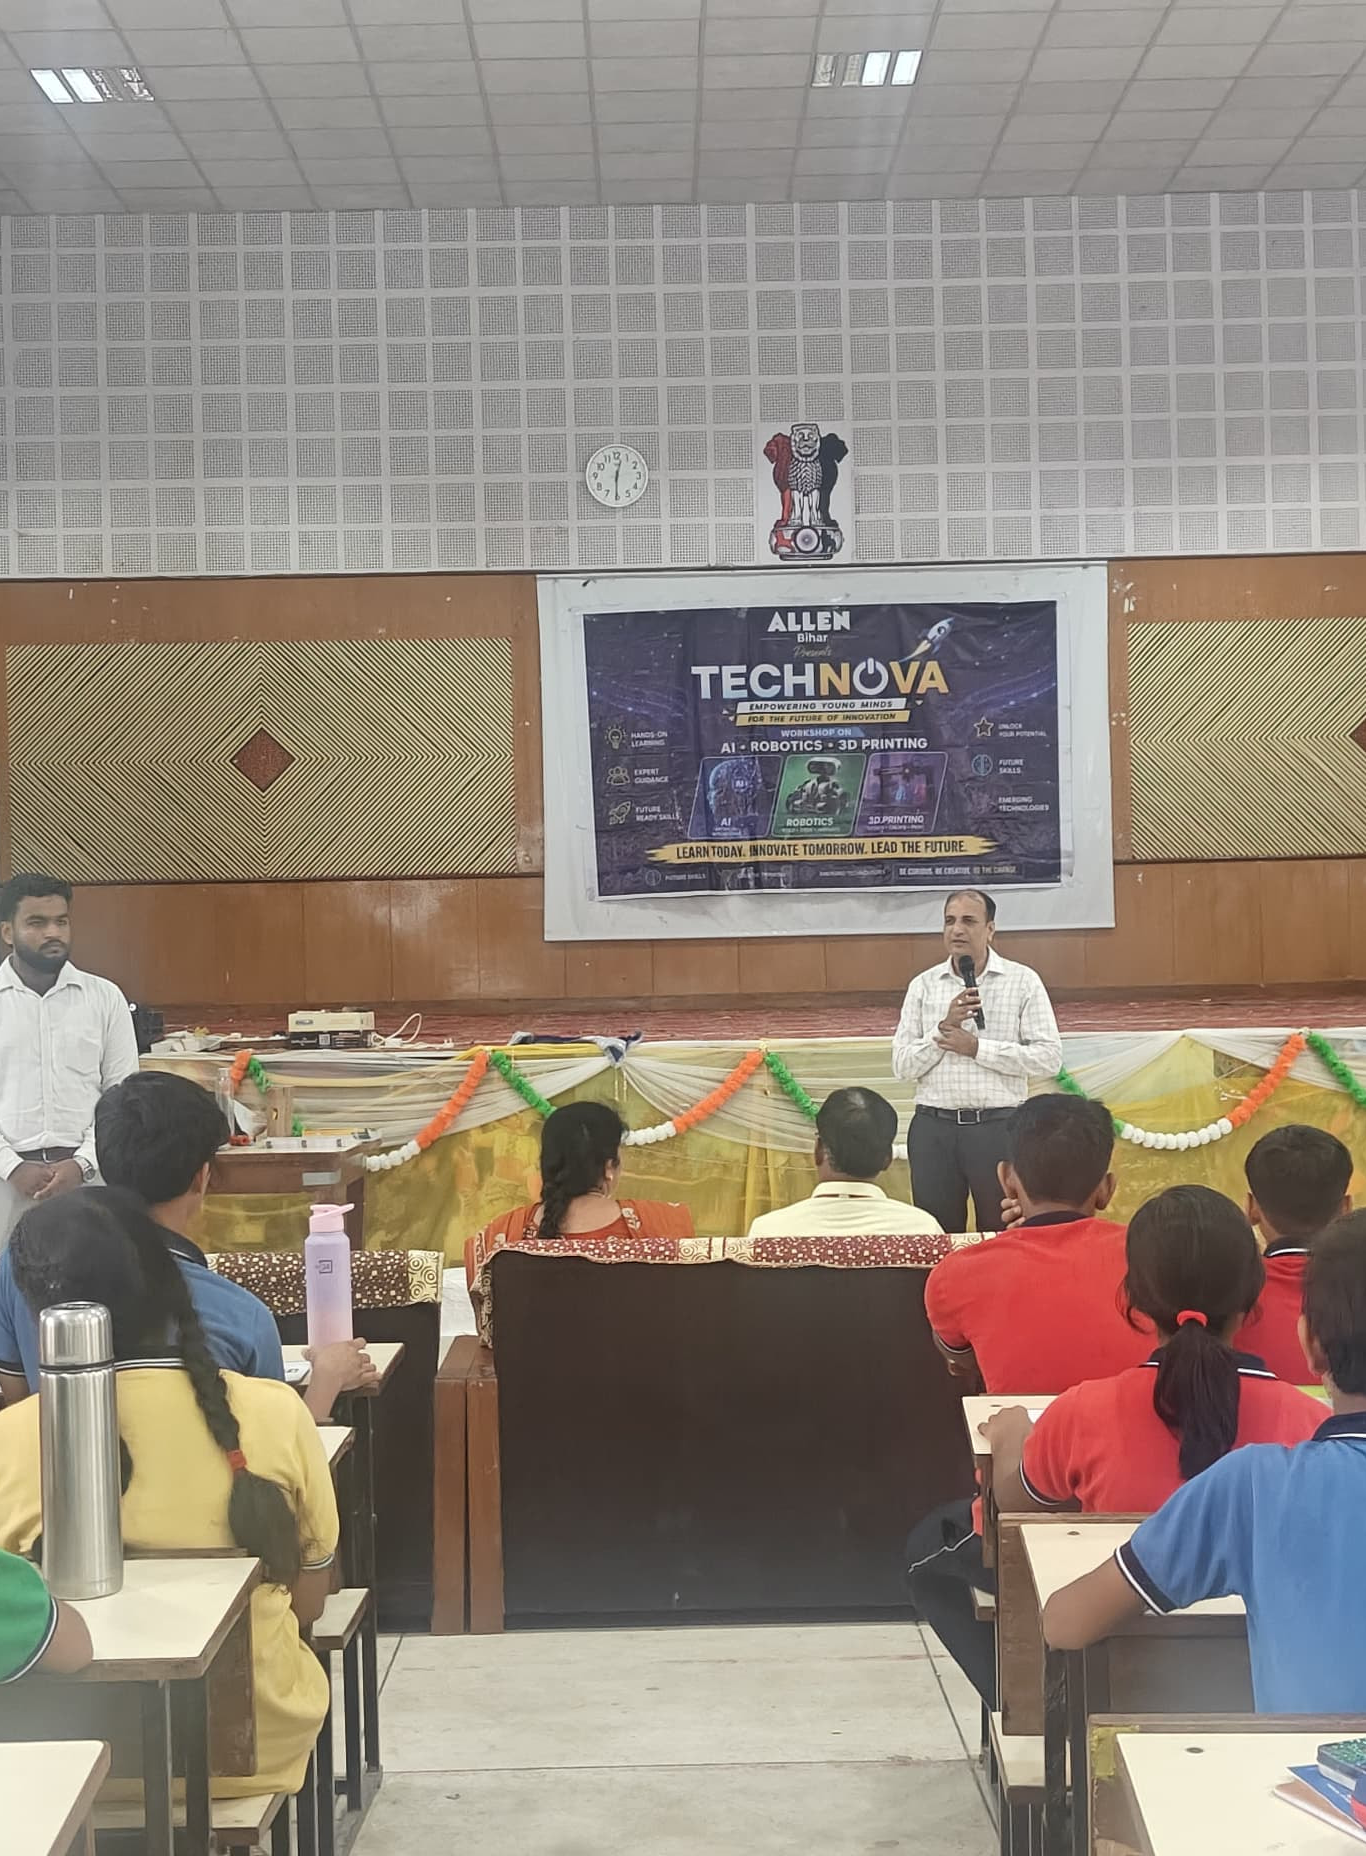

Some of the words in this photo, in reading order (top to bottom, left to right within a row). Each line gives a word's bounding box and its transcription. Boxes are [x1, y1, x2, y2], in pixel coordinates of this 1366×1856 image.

[767, 610, 851, 633] ALLEN
[797, 632, 828, 643] Bihar
[691, 657, 949, 699] TECHNOVA
[749, 702, 816, 711] EMPOWERING
[822, 701, 856, 710] YOUNG
[860, 701, 893, 709] MINDS
[769, 715, 785, 723] THE
[789, 714, 822, 722] FUTURE
[827, 714, 838, 722] OF
[842, 713, 896, 722] INNOVATION
[781, 728, 836, 738] WORKSHOP
[837, 728, 852, 736] ON
[721, 742, 736, 754] AI
[750, 740, 823, 753] ROBOTICS
[838, 739, 858, 751] 3D
[862, 738, 928, 750] PRINTING
[786, 817, 834, 827] ROBOTICS
[881, 815, 924, 825] PRINTING
[676, 846, 710, 860] LEARN
[711, 845, 747, 858] TODAY.
[749, 843, 799, 857] INNOVATE
[803, 842, 867, 856] TOMORROW.
[871, 841, 898, 855] LEAD
[901, 841, 921, 854] THE
